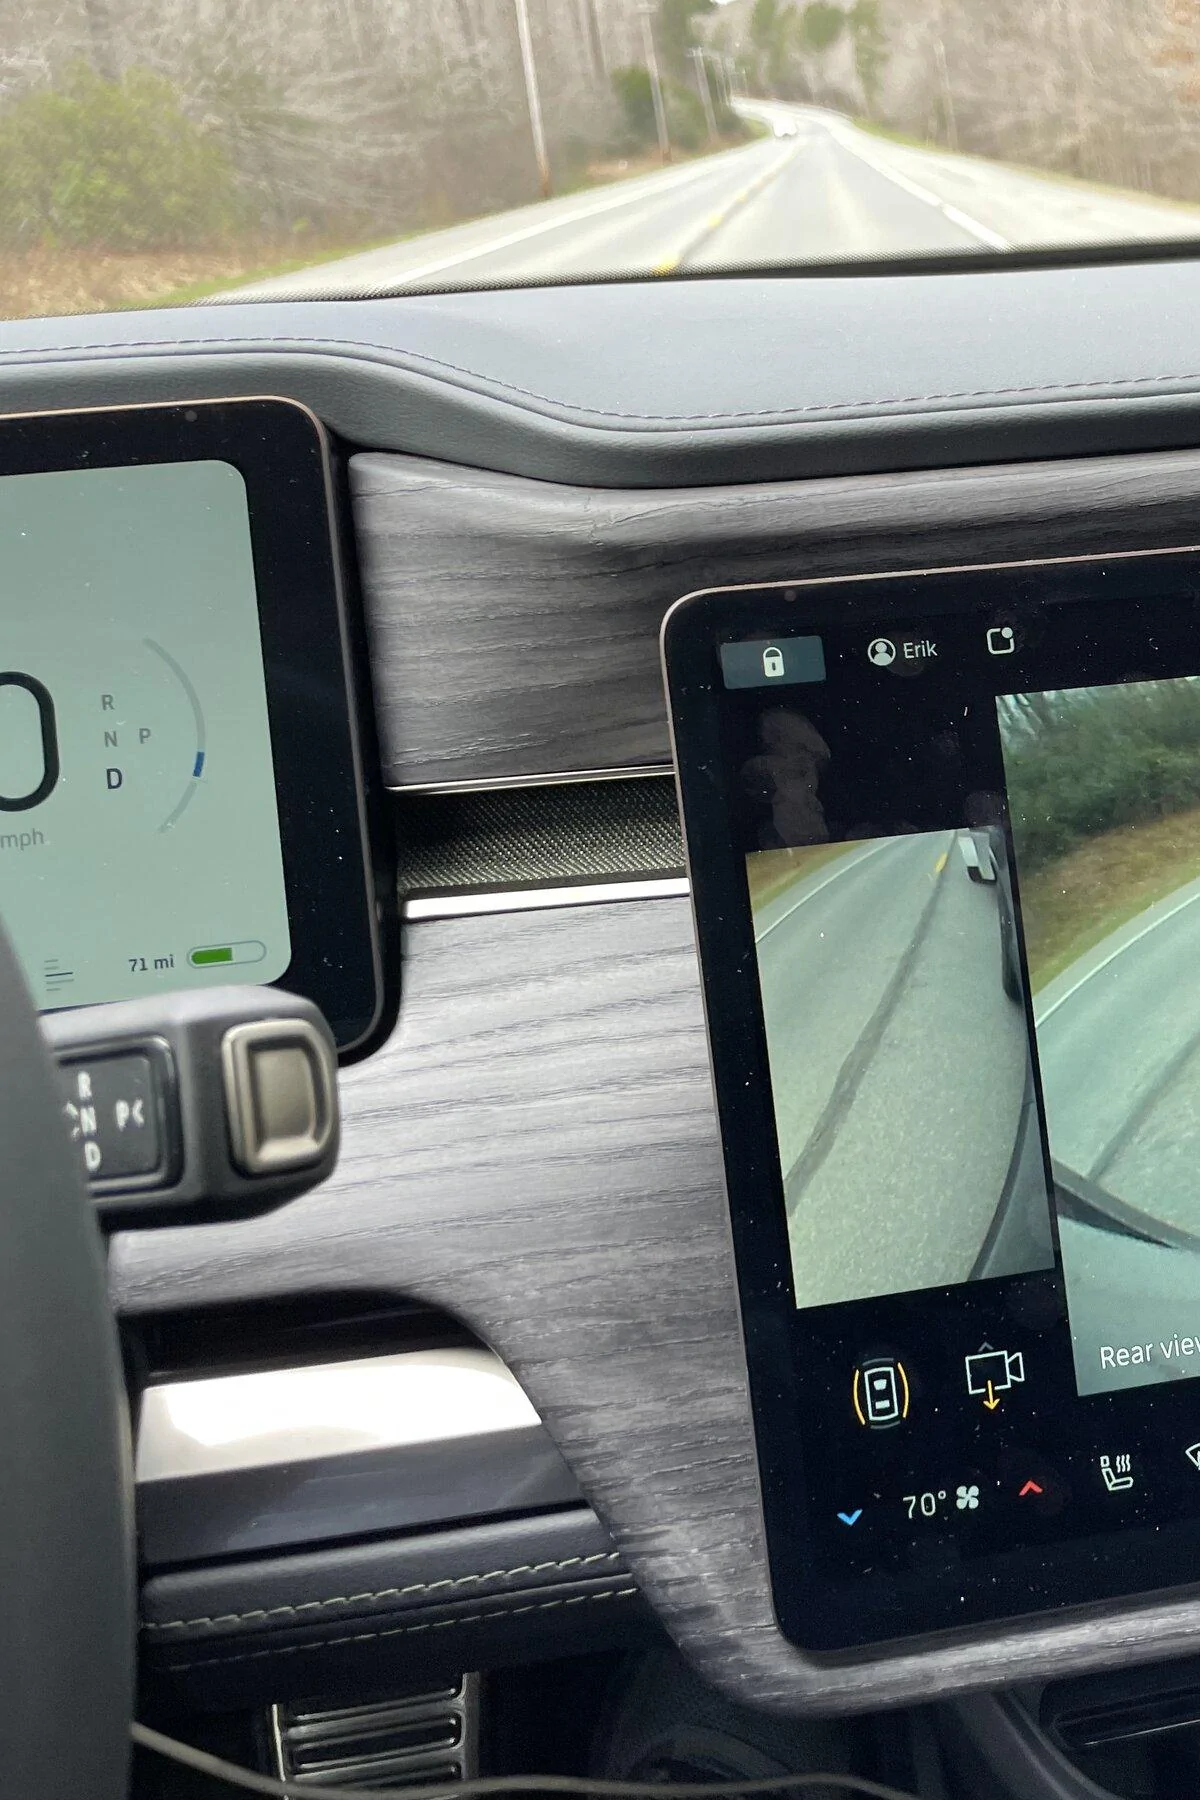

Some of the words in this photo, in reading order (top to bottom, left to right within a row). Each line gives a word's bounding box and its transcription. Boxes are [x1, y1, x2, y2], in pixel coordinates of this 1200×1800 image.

[903, 640, 938, 659] Erik
[102, 694, 115, 710] R
[104, 731, 118, 747] N
[139, 728, 151, 744] P
[106, 768, 123, 789] D
[0, 828, 44, 850] mph
[128, 958, 147, 972] 71
[154, 954, 174, 970] mi
[1100, 1343, 1152, 1370] Rear
[902, 1490, 947, 1519] 70°
